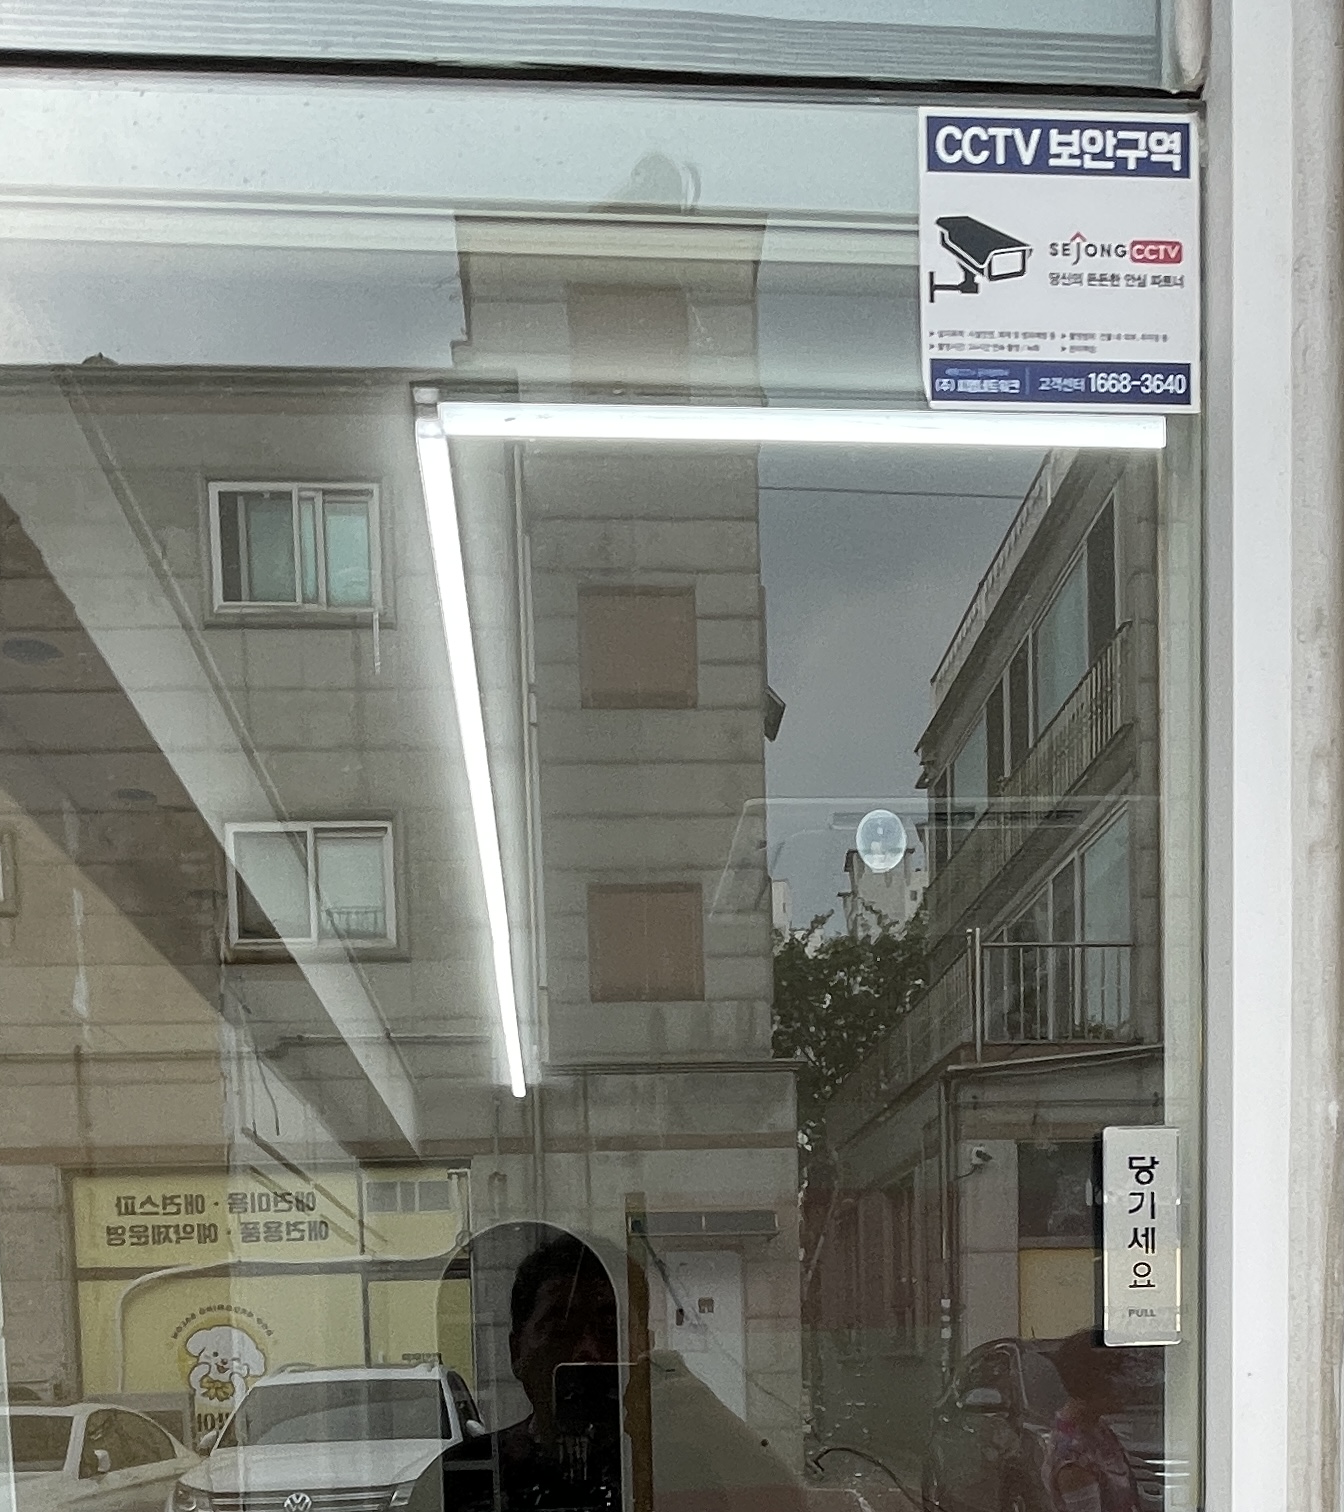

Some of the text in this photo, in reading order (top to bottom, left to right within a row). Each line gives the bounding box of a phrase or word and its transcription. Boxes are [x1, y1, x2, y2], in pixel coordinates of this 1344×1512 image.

[935, 125, 1182, 171] CCTV 보안구역
[1049, 240, 1181, 266] SEJONG CCTV
[1124, 274, 1147, 287] 안심
[1038, 377, 1086, 393] 고객센터
[1088, 372, 1187, 395] 1668-3640
[1128, 1156, 1159, 1289] 당기세요
[1128, 1308, 1157, 1319] PULL
